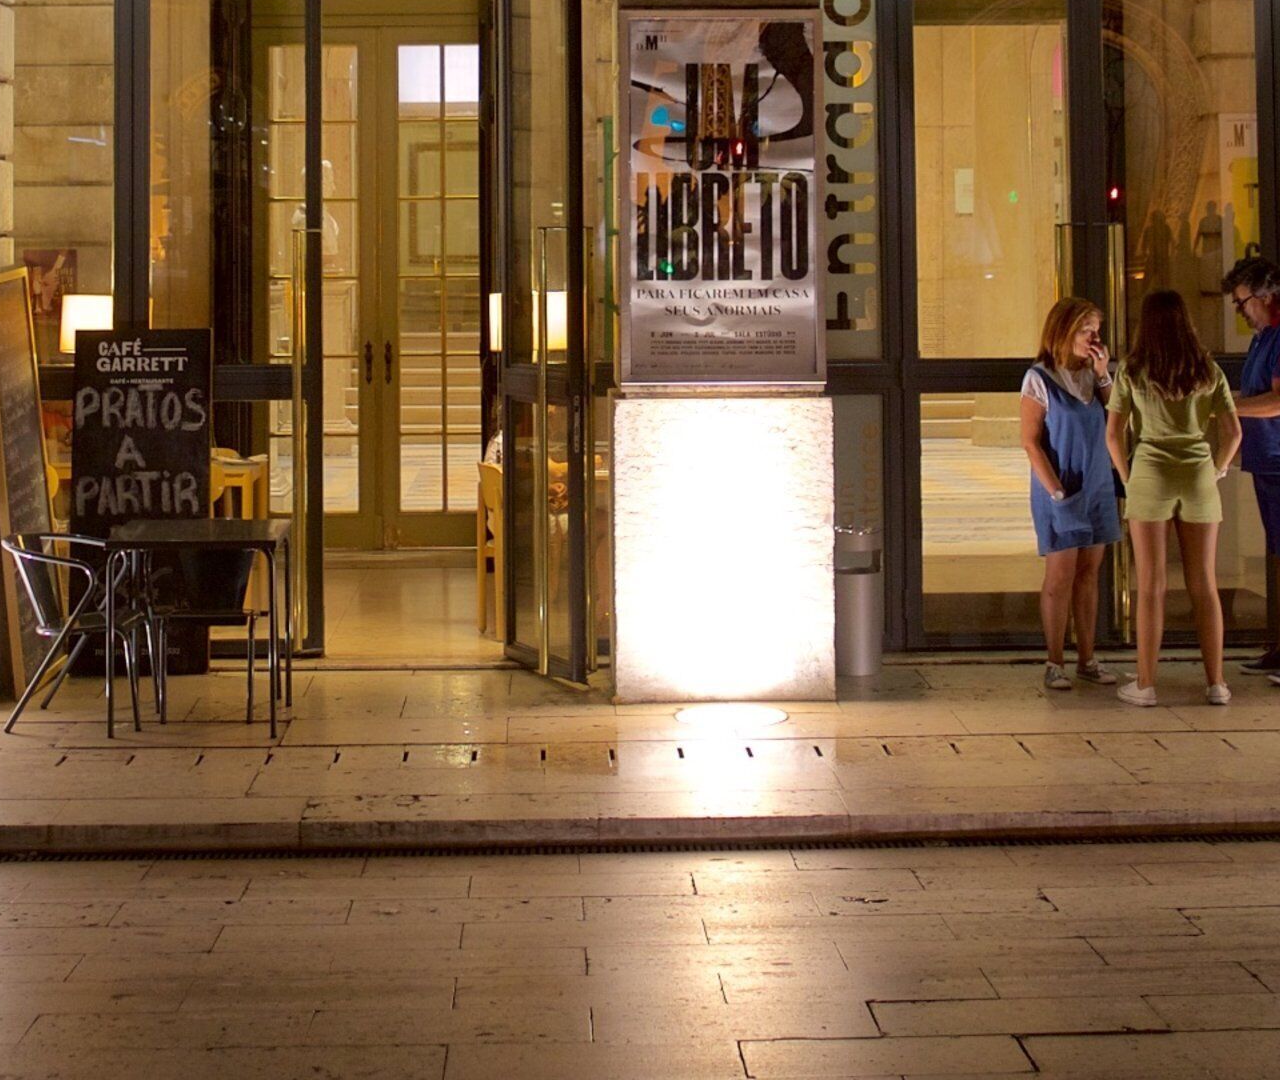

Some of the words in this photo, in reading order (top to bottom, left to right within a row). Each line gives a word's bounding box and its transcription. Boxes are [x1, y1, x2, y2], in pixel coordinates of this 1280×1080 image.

[636, 172, 809, 281] LIBRETO
[636, 288, 675, 300] PARA
[679, 287, 748, 299] FICAREM
[748, 287, 769, 299] EM
[772, 287, 810, 299] CASA
[664, 305, 701, 316] SEUS
[707, 305, 782, 316] ANORMAIS
[97, 337, 143, 357] CAFÉ
[95, 356, 189, 373] GARRETT
[74, 382, 206, 431] PRATOS
[114, 433, 147, 470] A
